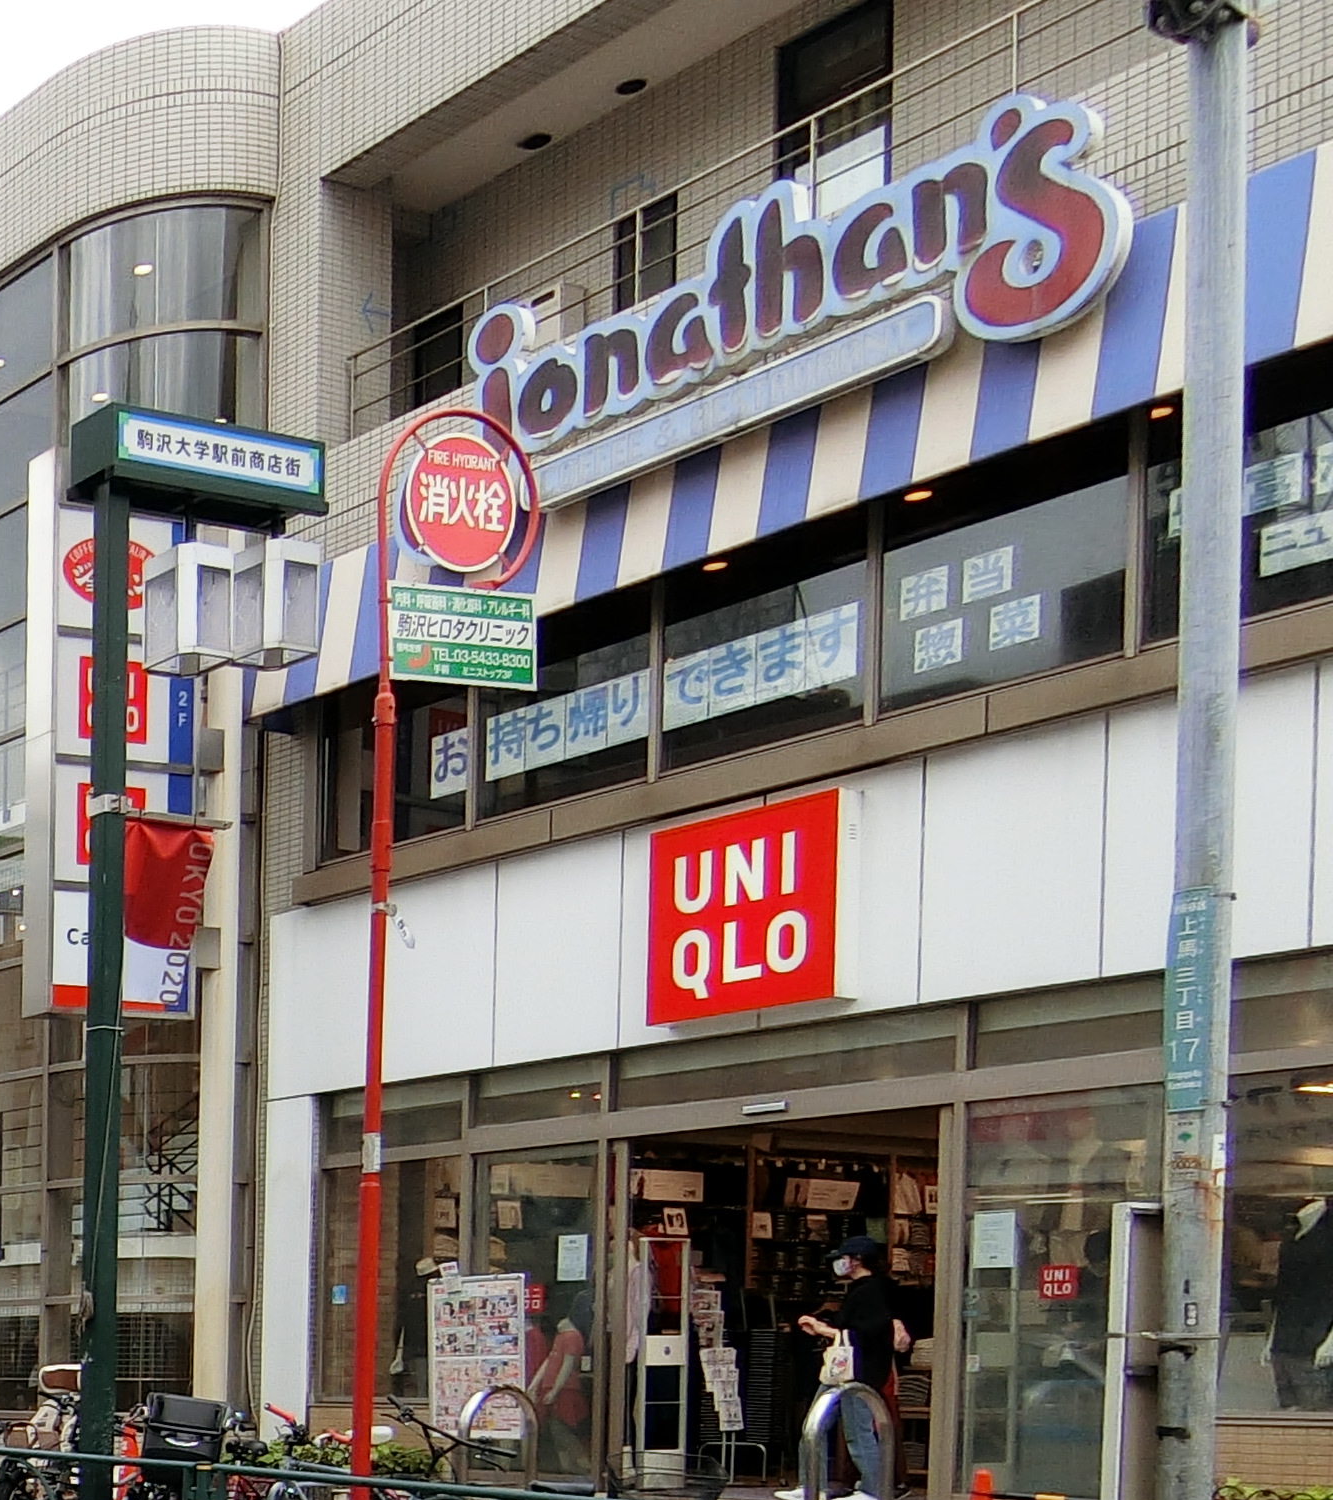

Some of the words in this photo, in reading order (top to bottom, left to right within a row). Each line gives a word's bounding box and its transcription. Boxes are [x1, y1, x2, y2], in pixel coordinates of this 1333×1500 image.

[135, 428, 302, 480] 駒沢大学駅前商店街
[427, 448, 451, 467] FIRE
[452, 452, 497, 472] HYDRANT
[418, 471, 507, 533] 消火栓
[397, 612, 530, 647] 駒沢ヒロタクリニック
[175, 841, 214, 925] OKYO
[672, 829, 797, 915] UNI
[66, 928, 90, 945] Ca
[670, 909, 808, 1000] QLO
[159, 930, 191, 1006] 2020
[1174, 916, 1198, 1031] 上馬三丁目
[1168, 1037, 1201, 1063] 17
[1042, 1268, 1071, 1283] UNI
[1042, 1282, 1072, 1296] QLO
